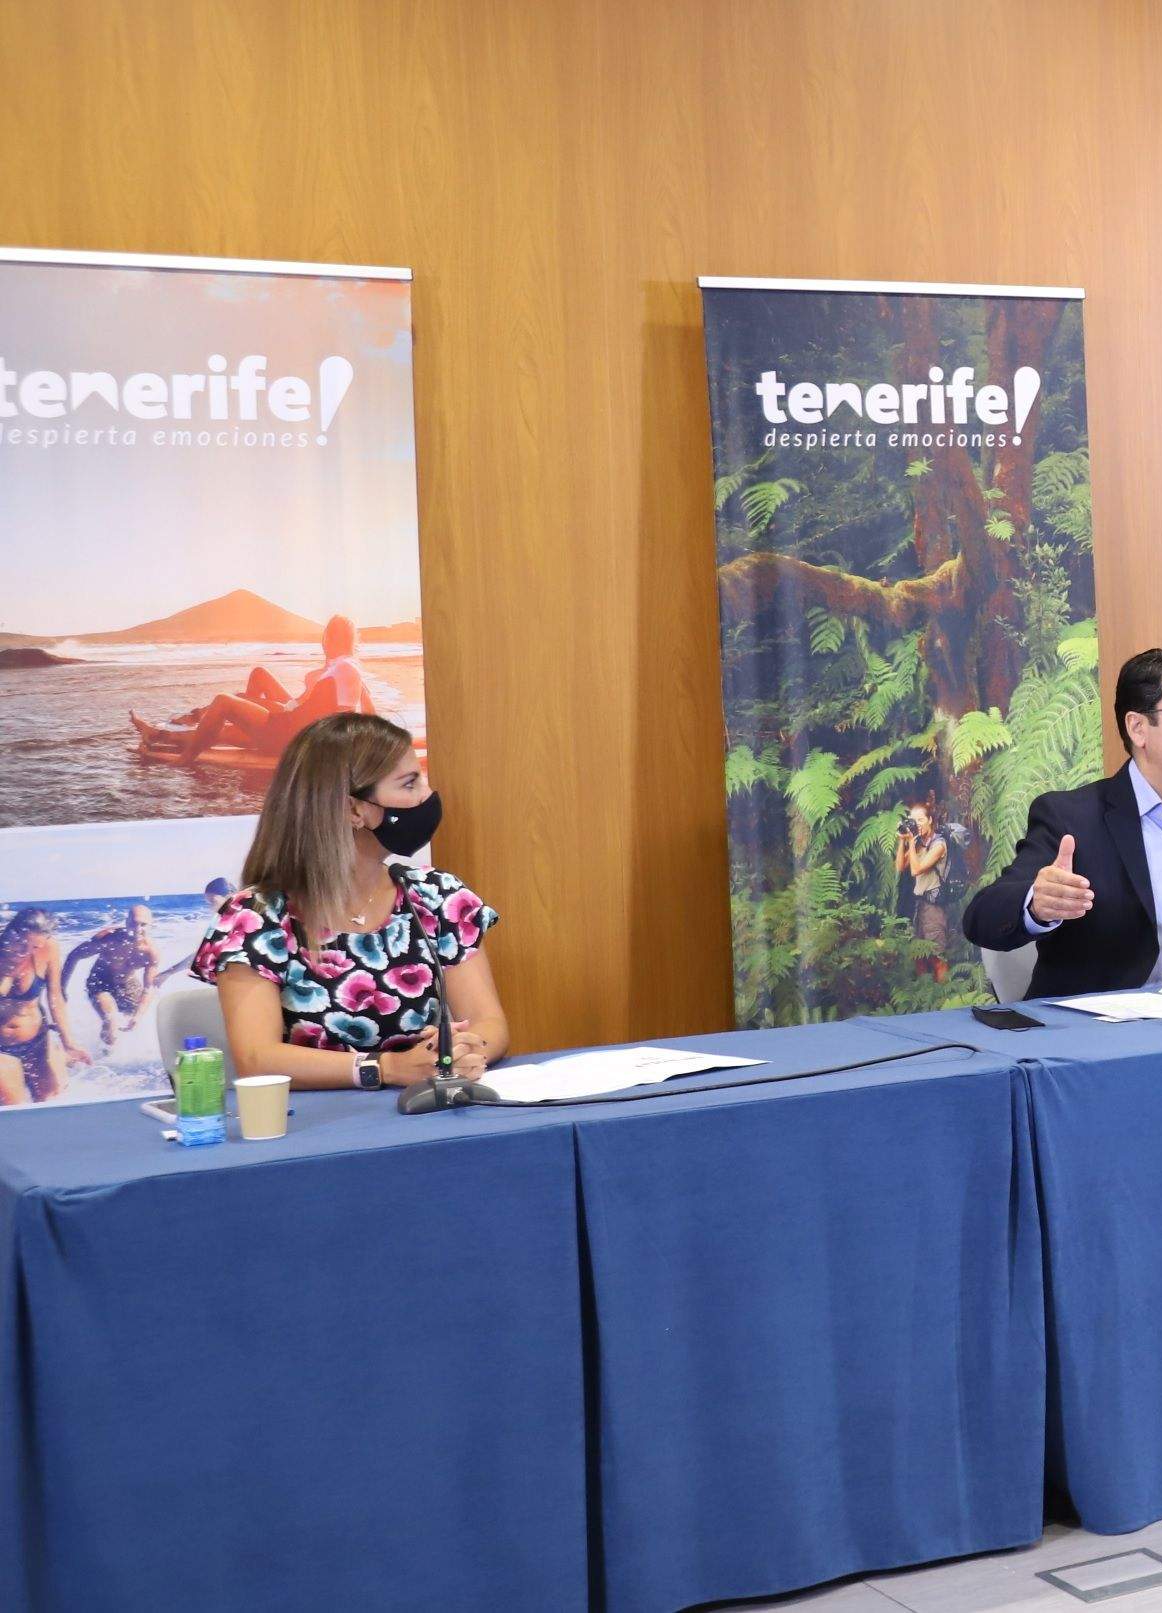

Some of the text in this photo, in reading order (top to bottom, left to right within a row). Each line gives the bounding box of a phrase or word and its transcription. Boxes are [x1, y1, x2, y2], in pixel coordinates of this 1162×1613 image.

[755, 366, 1041, 446] tenerife!
[0, 422, 309, 448] espierta emociones
[764, 428, 1007, 450] despierta emociones
